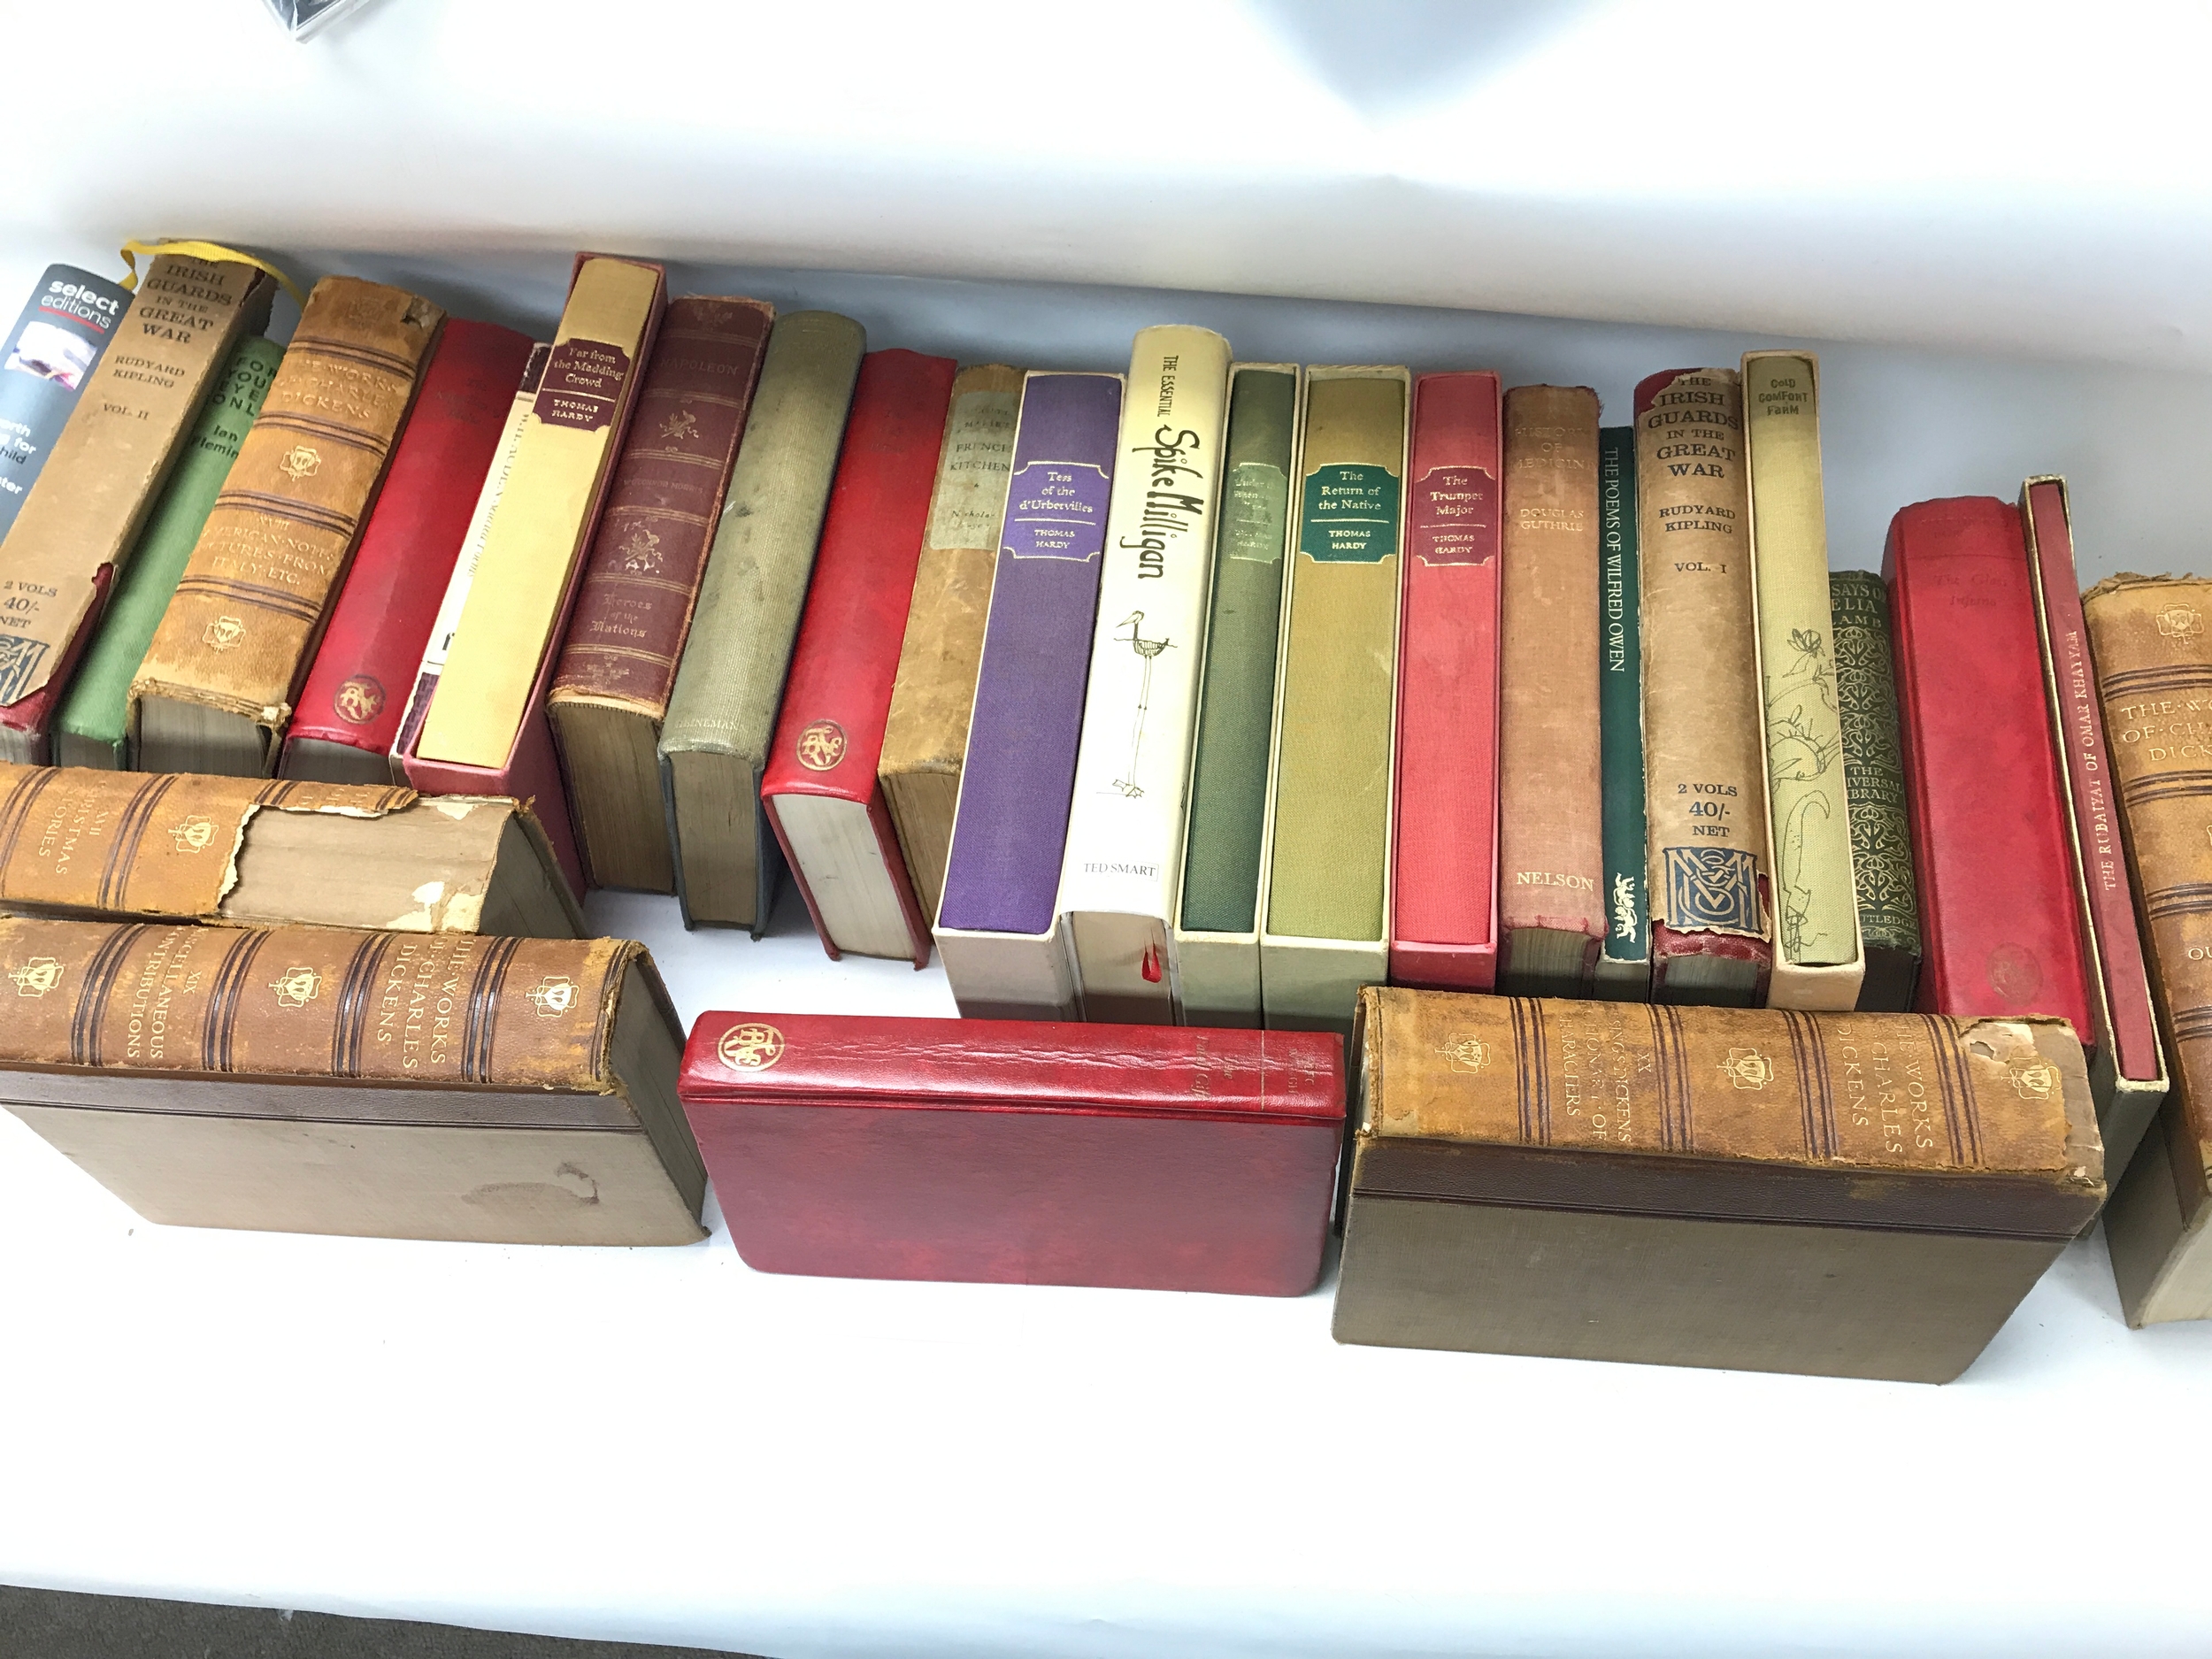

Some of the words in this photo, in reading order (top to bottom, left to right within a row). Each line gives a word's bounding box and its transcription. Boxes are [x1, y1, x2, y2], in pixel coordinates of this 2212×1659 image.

[166, 265, 224, 286] IRISH
[49, 280, 119, 316] select
[147, 278, 233, 307] GUARDS
[41, 294, 112, 331] editions
[156, 295, 171, 306] IN
[179, 301, 209, 313] THE
[139, 306, 214, 332] GREAT
[142, 322, 191, 344] WAR
[569, 346, 589, 358] Far
[590, 349, 617, 365] from
[1163, 355, 1179, 372] THE
[115, 355, 185, 378] RUDYARD
[554, 358, 572, 369] the
[573, 359, 625, 381] Madding
[660, 357, 739, 376] NAPOLEON
[112, 369, 175, 388] KIPLING
[230, 369, 267, 389] YOU
[565, 373, 603, 388] Crowd
[219, 380, 261, 403] EYE
[1156, 375, 1176, 418] ESSENTIAL
[1659, 390, 1725, 407] IRISH
[212, 393, 255, 418] ONL
[281, 389, 372, 419] DICKENS
[553, 399, 599, 414] THOMAS
[138, 408, 150, 420] II
[551, 410, 594, 423] HARDY
[1647, 410, 1739, 431] GUARDS
[0, 418, 31, 438] orth
[213, 425, 238, 442] Ian
[1666, 429, 1685, 440] IN
[1691, 428, 1724, 441] THE
[0, 445, 27, 465] hild
[15, 436, 36, 455] for
[1540, 442, 1563, 453] OF
[1656, 442, 1736, 462] GREAT
[1132, 424, 1204, 488] Spike
[1604, 447, 1619, 477] THE
[949, 460, 1011, 472] KITCHEN
[1667, 463, 1725, 479] WAR
[0, 474, 23, 495] ter
[1047, 472, 1072, 482] Tess
[1339, 471, 1364, 481] The
[1442, 475, 1468, 486] The
[1041, 485, 1056, 495] of
[1056, 486, 1076, 496] the
[1321, 486, 1364, 495] Return
[1367, 486, 1382, 495] of
[1430, 490, 1484, 503] Trumpet
[1018, 499, 1094, 513] d'Urbervilles
[1318, 500, 1338, 510] the
[1341, 499, 1382, 511] Native
[1435, 505, 1475, 517] Major
[1520, 508, 1585, 518] DOUGLAS
[1605, 479, 1621, 529] POEMS
[1658, 504, 1736, 519] RUDYARD
[1033, 529, 1076, 538] THOMAS
[1119, 490, 1204, 580] Milligan
[1521, 520, 1584, 531] GUTHRIE
[1664, 520, 1733, 534] KIPLING
[1035, 541, 1071, 549] HARDY
[1332, 541, 1368, 550] HARDY
[1434, 545, 1473, 555] HARDY
[1606, 531, 1622, 551] OF
[1674, 562, 1712, 572] VOL.
[1719, 564, 1727, 574] I
[4, 580, 13, 590] 2
[18, 581, 58, 598] VOLS
[1607, 553, 1624, 619] WILFRED
[1831, 583, 1870, 597] SAYS
[3, 595, 41, 615] 40/-
[1831, 597, 1878, 614] ELIA
[589, 619, 648, 639] Nations
[1608, 622, 1625, 672] OWEN
[2065, 630, 2089, 700] KHAYYAM
[2121, 701, 2176, 719] THE
[2078, 703, 2093, 748] OMAR
[2123, 725, 2156, 743] OF
[2084, 752, 2099, 772] OF
[2148, 744, 2212, 761] DICK
[1849, 765, 1884, 778] THE
[1678, 784, 1687, 795] 2
[1693, 783, 1738, 797] VOLS
[1847, 777, 1902, 795] IVERSAL
[1688, 801, 1731, 821] 40/-
[2091, 780, 2112, 854] RUBAIYAT
[38, 788, 77, 857] STORIES
[55, 783, 103, 875] HRISTMAS
[1692, 825, 1731, 838] NET
[1083, 863, 1109, 873] TED
[1110, 863, 1156, 877] SMART
[2104, 859, 2117, 891] THE
[1516, 872, 1594, 892] NELSON
[1860, 913, 1917, 929] UTLEDGE
[447, 939, 477, 971] THE
[2187, 946, 2212, 961] OU
[182, 970, 203, 995] XIX
[127, 927, 186, 1059] ONTRIBUTIONS
[377, 944, 419, 1042] DICKENS
[403, 961, 435, 1069] CHARLES
[430, 976, 460, 1064] WORKS
[1637, 1052, 1652, 1073] XX
[1836, 1023, 1869, 1126] DICKENS
[1871, 1041, 1903, 1154] CHARLES
[1904, 1058, 1934, 1148] WORKS
[1592, 1113, 1607, 1141] OF
